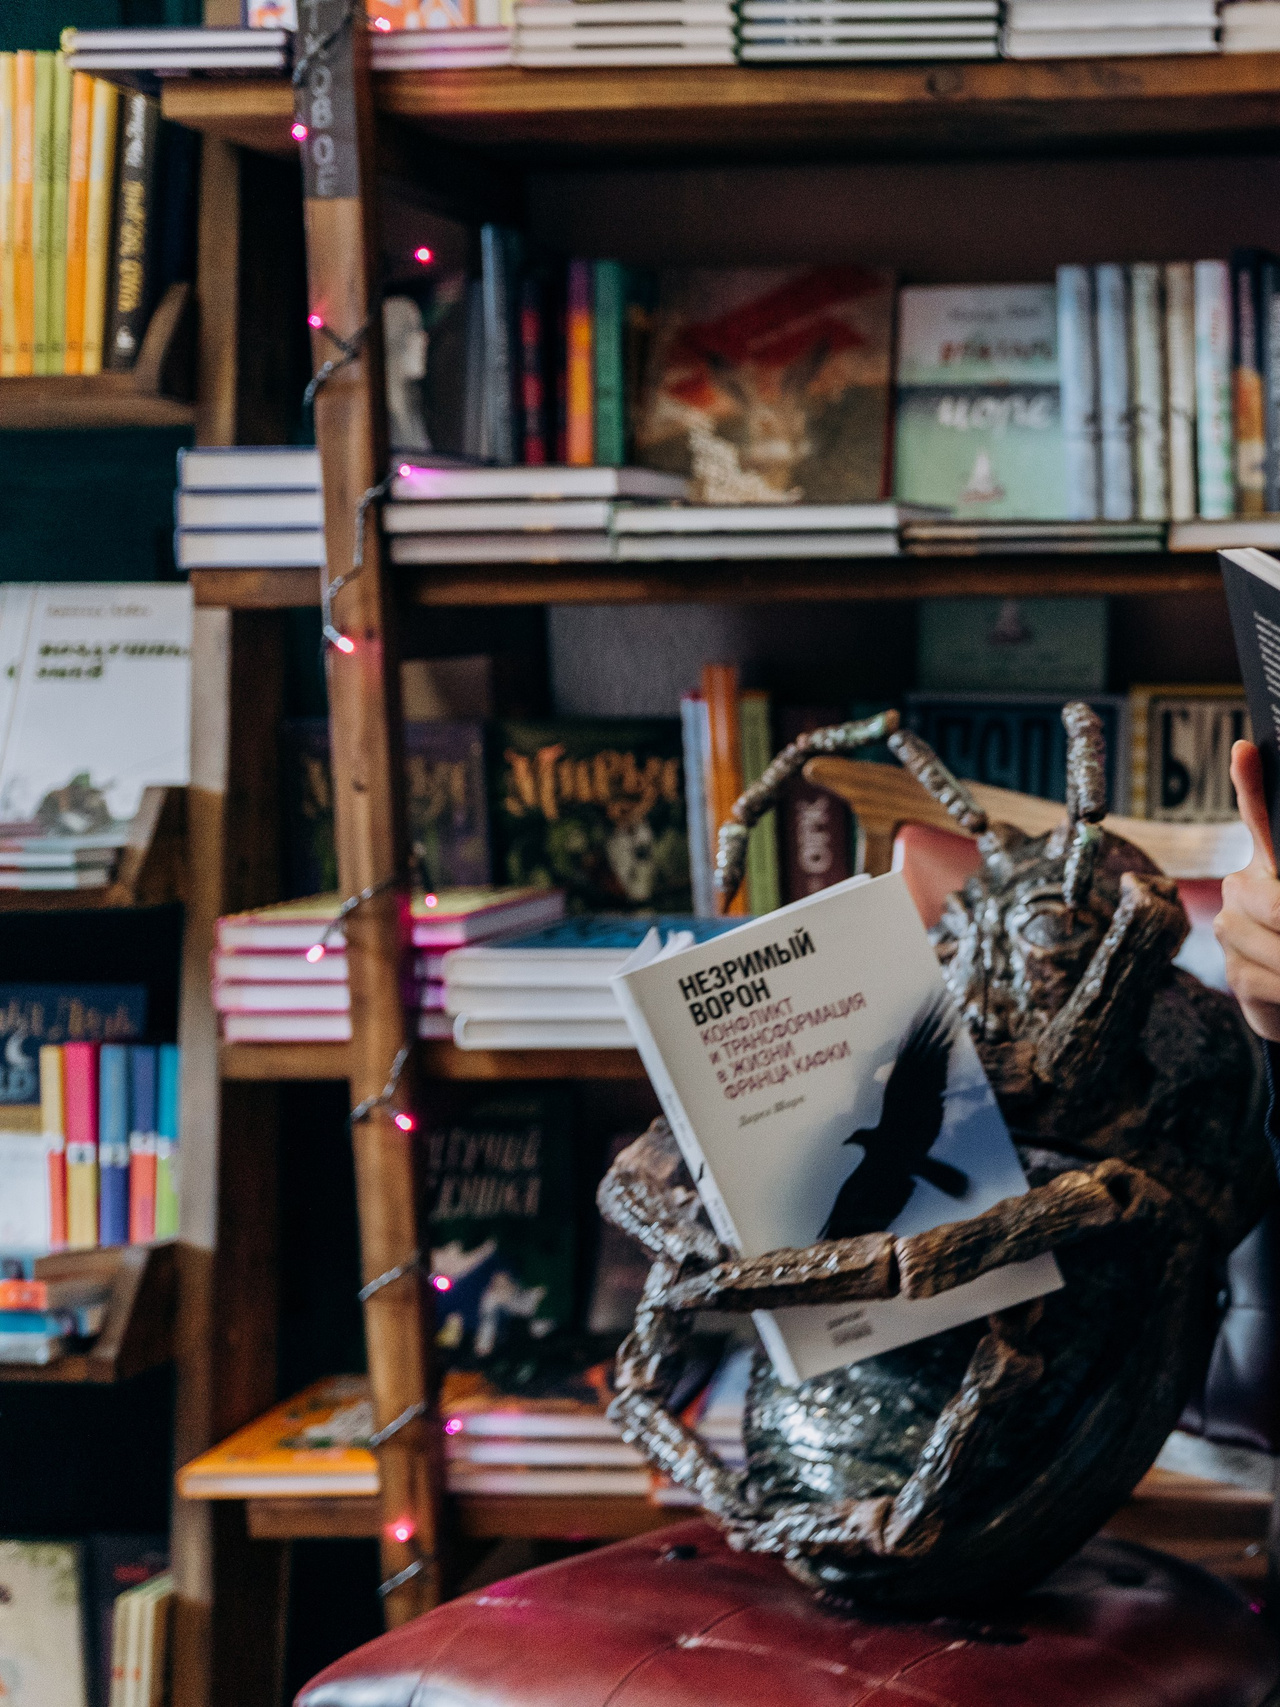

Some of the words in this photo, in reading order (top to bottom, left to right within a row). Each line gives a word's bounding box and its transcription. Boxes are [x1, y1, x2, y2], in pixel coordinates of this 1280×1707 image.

[678, 927, 816, 1001] НЕЗРИМЫЙ
[689, 977, 771, 1026] ВОРОН
[701, 996, 793, 1046] КОНФЛИКТ
[721, 992, 867, 1059] ТРАНСФОРМАЦИЯ
[723, 1063, 793, 1100] ФРАНЦА
[793, 1040, 852, 1075] КАФКИ
[729, 1040, 796, 1078] ЖИЗНИ
